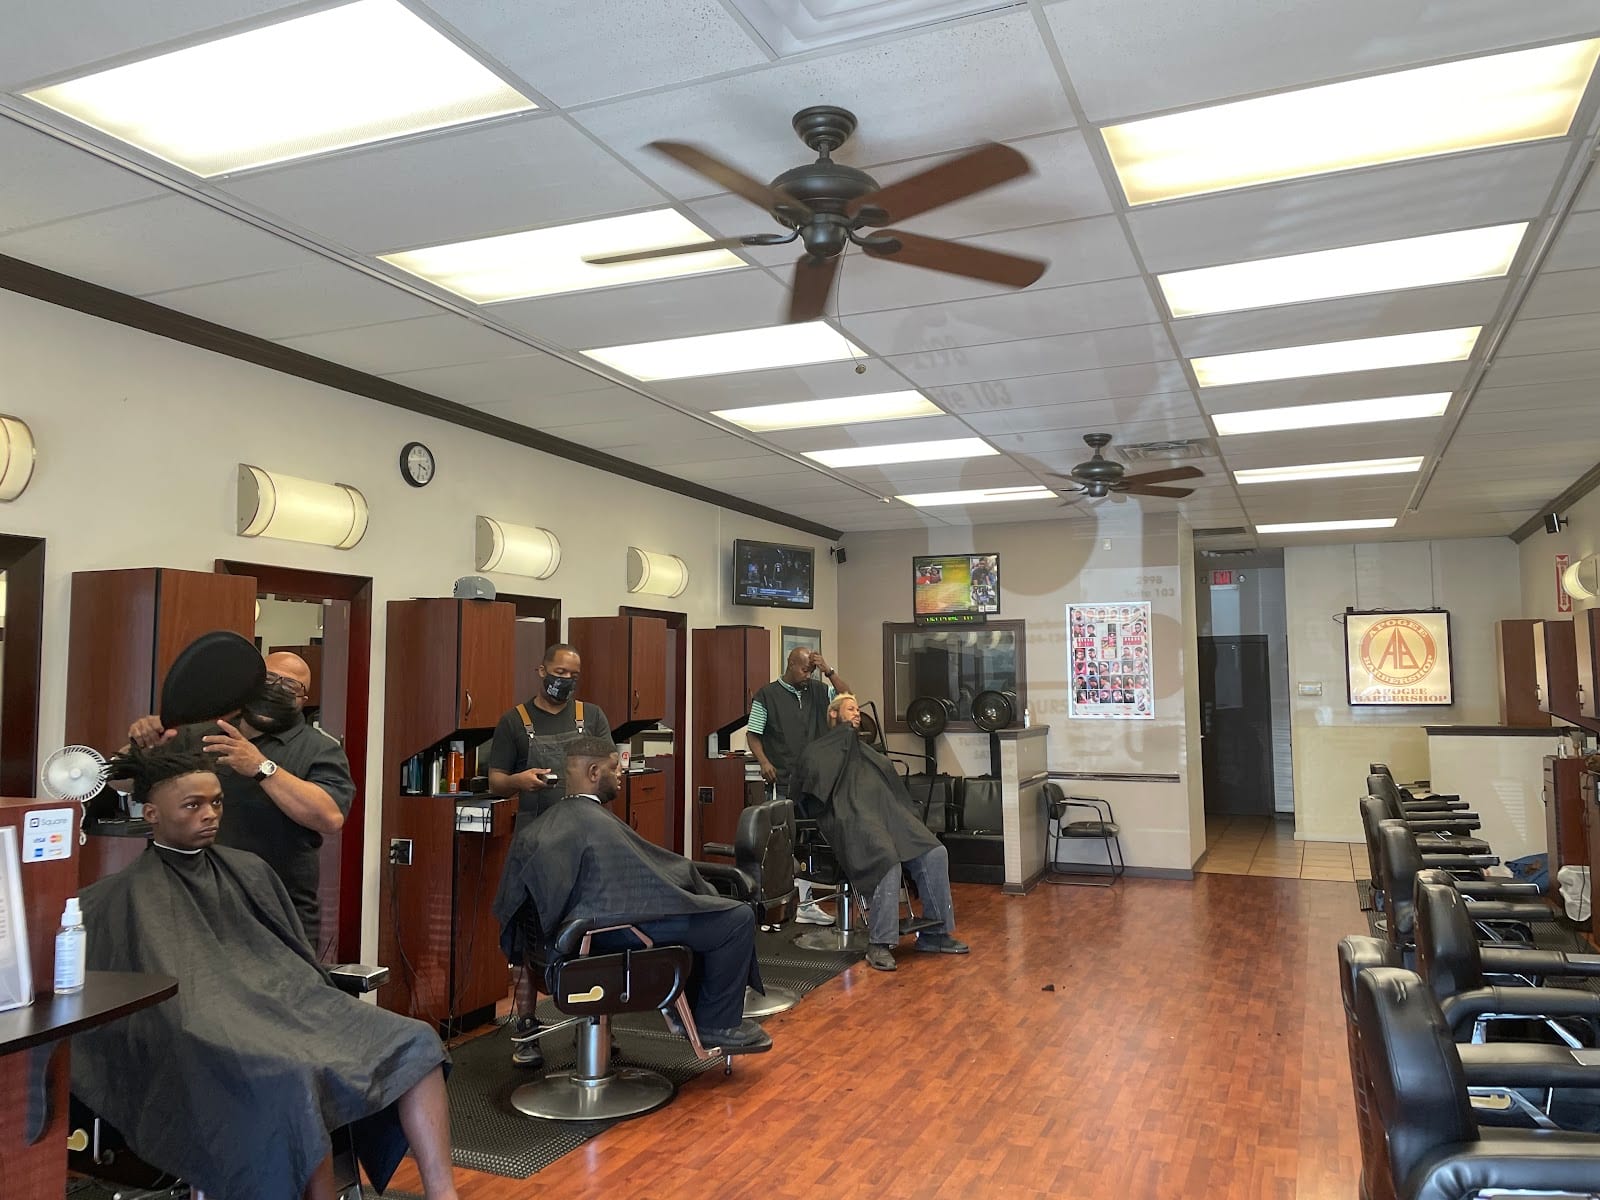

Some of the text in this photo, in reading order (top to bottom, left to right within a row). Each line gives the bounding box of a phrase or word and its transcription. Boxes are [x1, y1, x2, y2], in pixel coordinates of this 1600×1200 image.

[1368, 618, 1428, 638] APOGEE
[1363, 654, 1435, 685] BARBERSHOP
[1373, 687, 1428, 695] APOGEE
[1353, 695, 1448, 703] BARBERSHOP
[41, 818, 68, 826] Square
